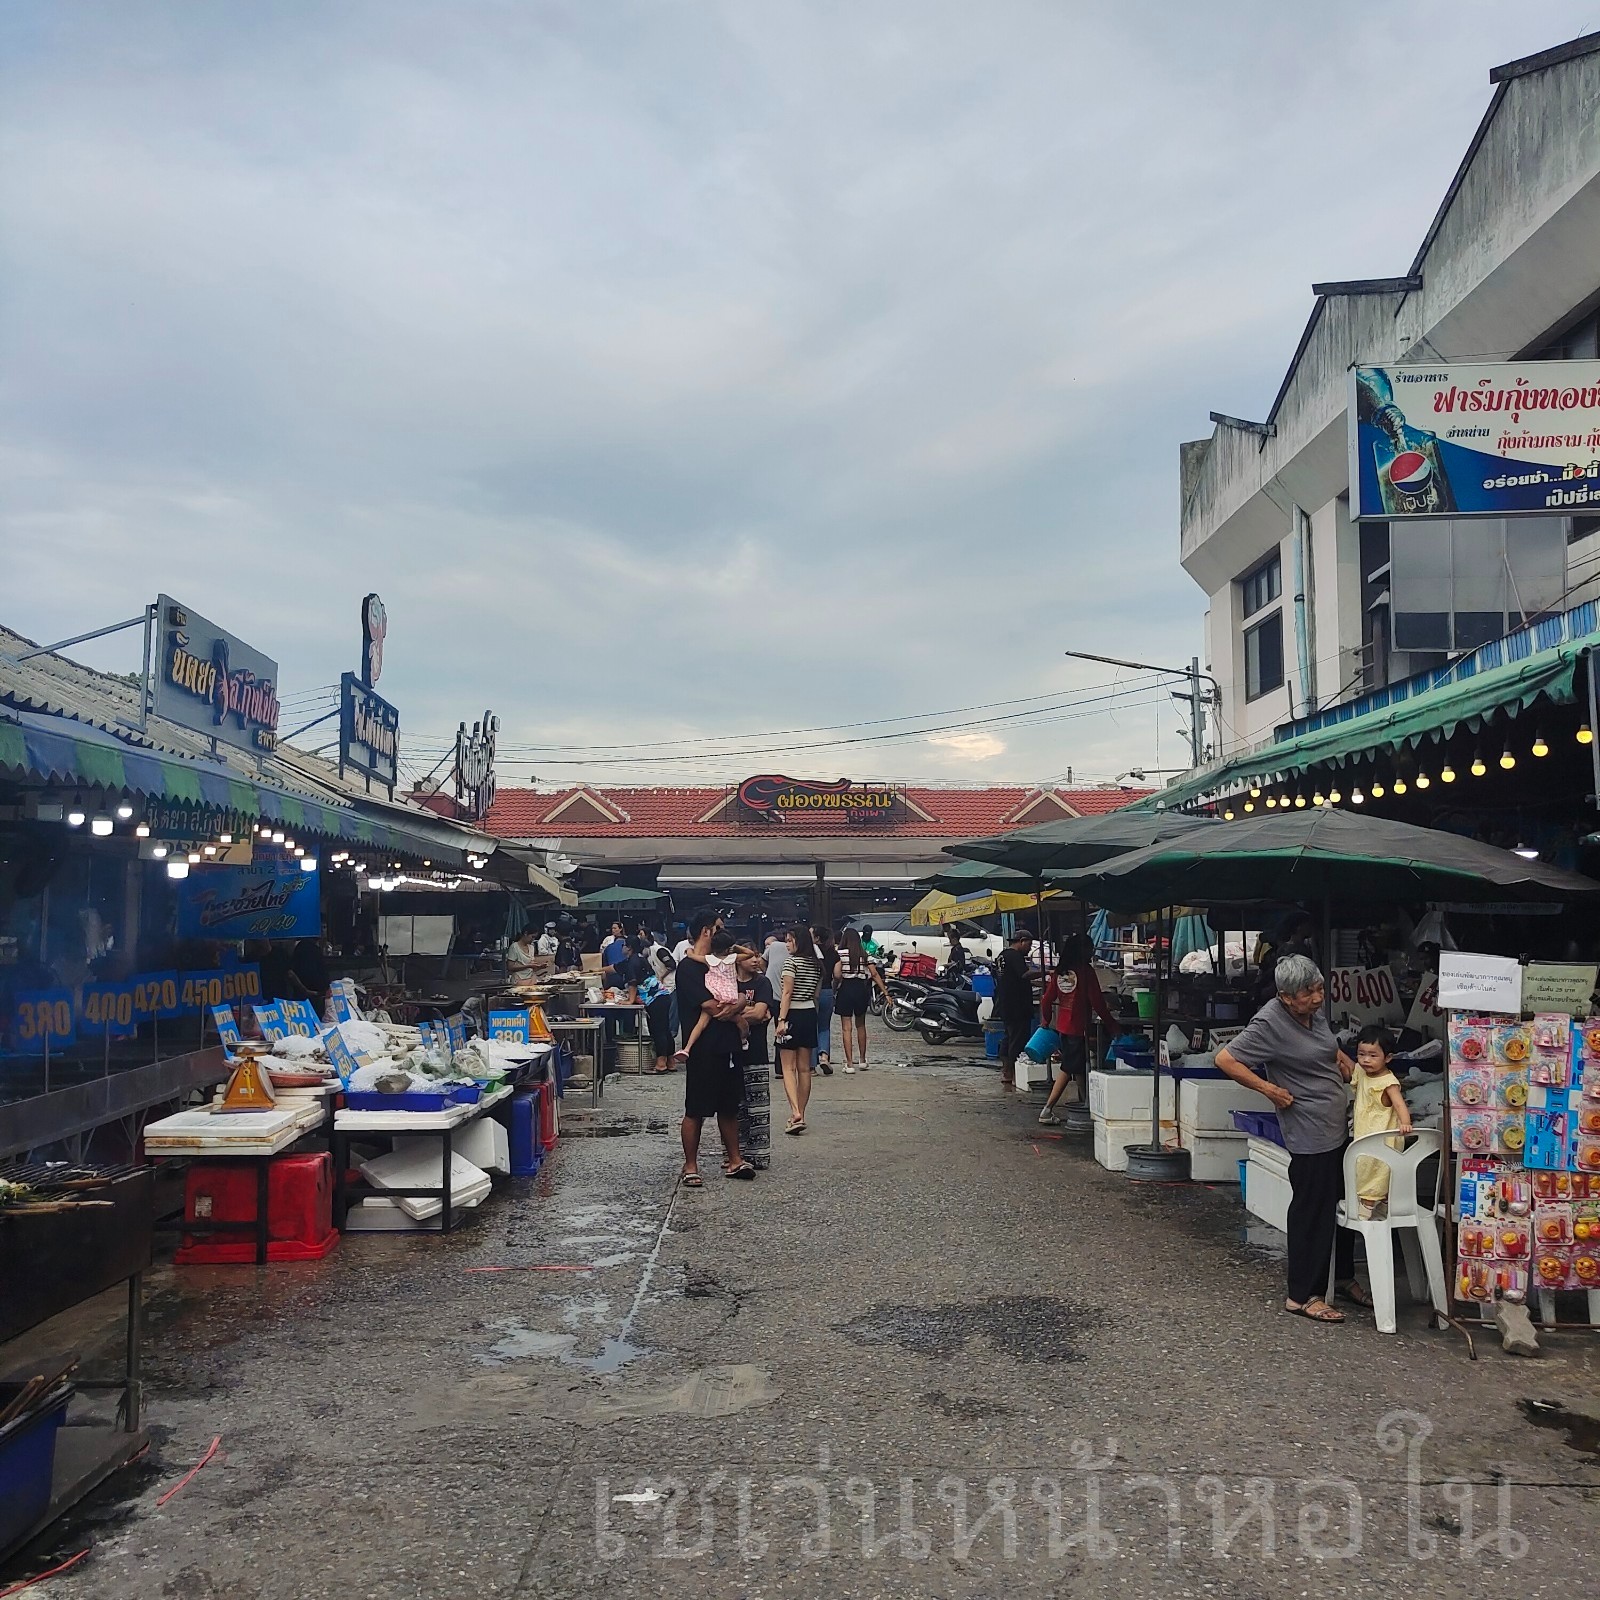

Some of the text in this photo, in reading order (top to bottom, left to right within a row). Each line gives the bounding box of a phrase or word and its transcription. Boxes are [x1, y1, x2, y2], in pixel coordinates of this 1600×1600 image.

[1395, 371, 1449, 384] ร้านอาหาร
[1446, 424, 1490, 438] จำหน่าย
[777, 787, 892, 809] ผ่องพรรณ
[134, 979, 177, 1012] 420
[181, 978, 222, 1008] 450
[223, 971, 260, 1000] 600
[1329, 969, 1360, 1003] 38
[1357, 970, 1393, 1008] 400
[18, 1001, 71, 1039] 380
[85, 992, 133, 1026] 400
